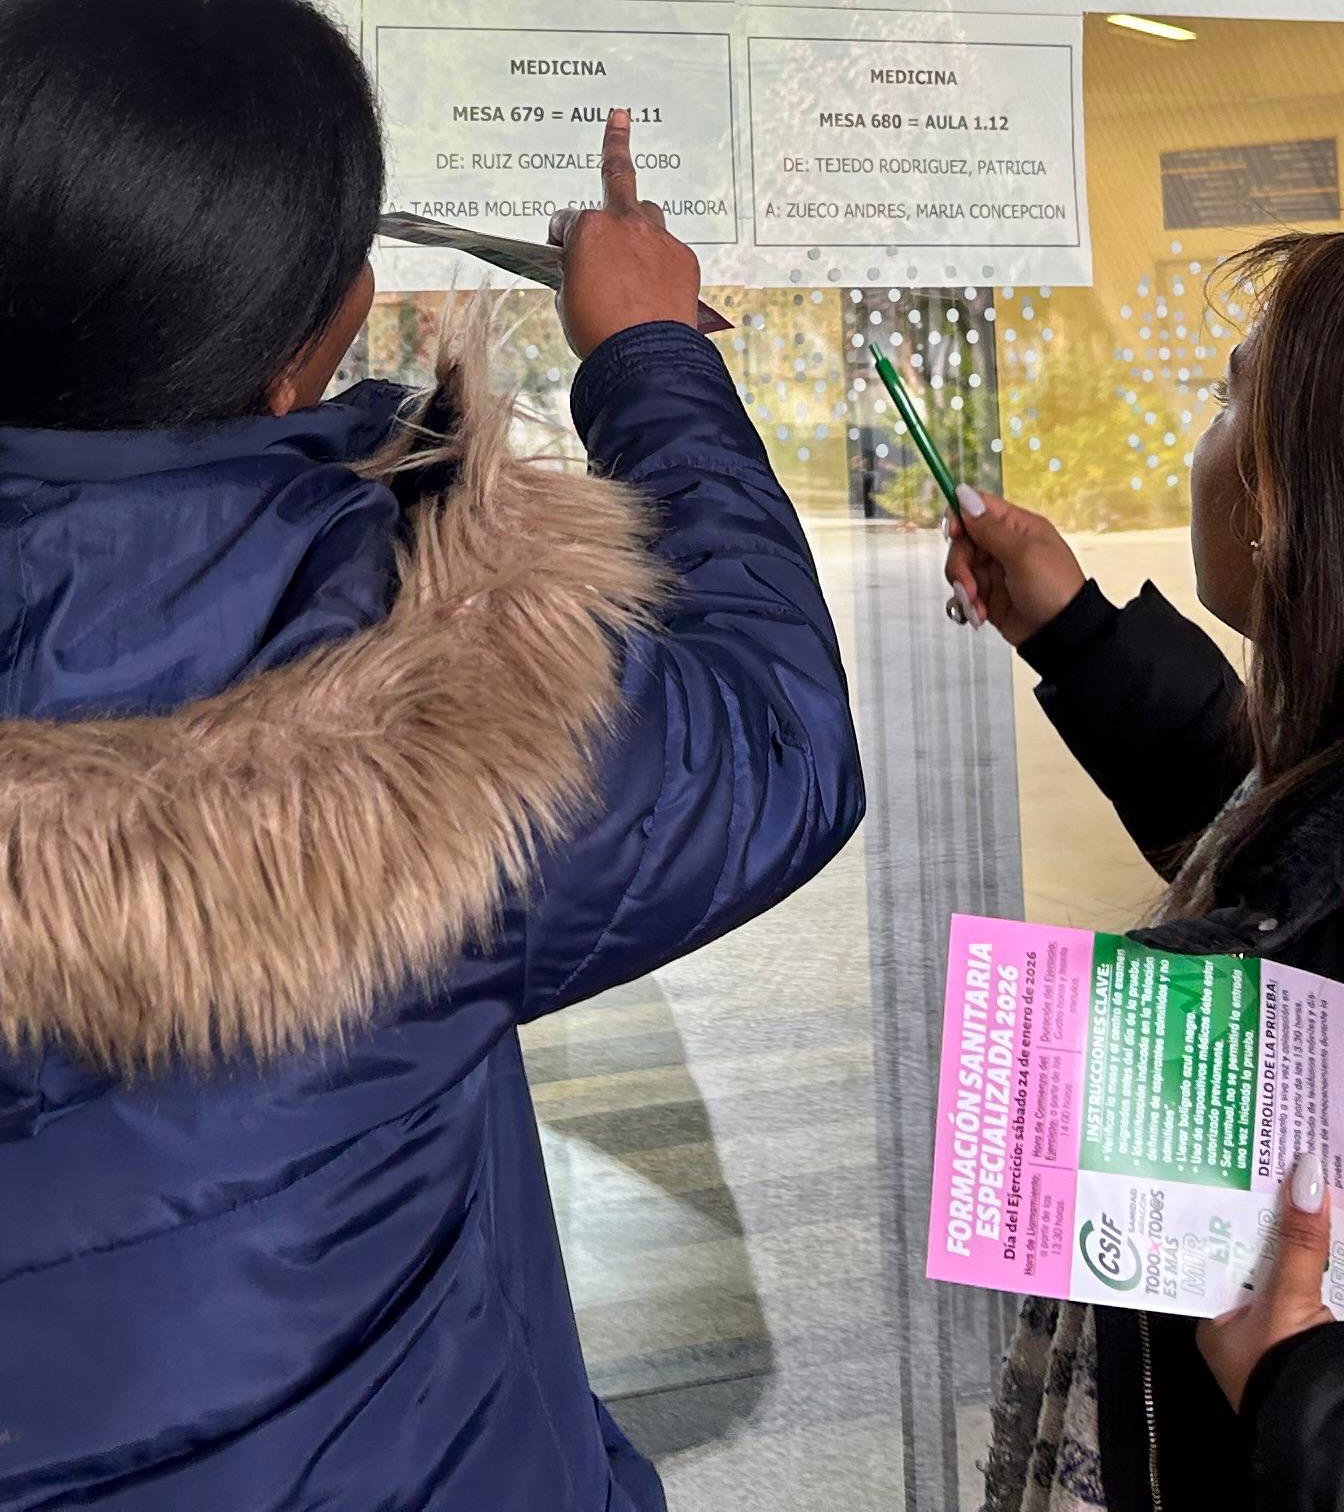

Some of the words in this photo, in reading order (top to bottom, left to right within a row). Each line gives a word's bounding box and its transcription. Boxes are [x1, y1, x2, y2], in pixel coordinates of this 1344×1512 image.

[510, 60, 607, 76] MEDICINA
[870, 69, 958, 85] MEDICINA
[819, 112, 866, 128] MESA
[871, 113, 902, 129] 680
[908, 118, 919, 127] =
[925, 115, 968, 130] AULA
[974, 116, 1009, 131] 1.12
[783, 157, 810, 173] DE:
[814, 157, 874, 174] TEJEDO
[879, 158, 972, 177] RODRIGUEZ,
[977, 160, 1047, 176] PATRICIA
[765, 202, 781, 218] A:
[786, 202, 839, 219] ZUECO
[843, 203, 911, 221] ANDRES,
[916, 203, 965, 219] MARIA
[969, 203, 1065, 220] CONCEPCION
[1026, 952, 1036, 985] 2026
[1022, 988, 1034, 1004] de
[1095, 964, 1109, 1015] CLAVE:
[962, 944, 992, 1089] SANITARIA
[1022, 1007, 1032, 1047] enero
[1017, 1049, 1030, 1067] de
[1265, 1042, 1275, 1058] LA
[1018, 1070, 1029, 1087] 24
[1087, 1016, 1105, 1142] INSTRUCCIONES
[1264, 1060, 1275, 1080] DE
[976, 1030, 1014, 1240] ESPECIALIZADA
[995, 965, 1018, 1027] 2026
[1012, 1089, 1027, 1140] sábado
[1258, 1082, 1274, 1177] DESARROLLO
[947, 1090, 980, 1256] FORMACIÓN
[1007, 1143, 1023, 1207] Ejercicio:
[1005, 1210, 1018, 1233] del
[1003, 1236, 1016, 1260] Día
[1098, 1214, 1122, 1274] CSIF
